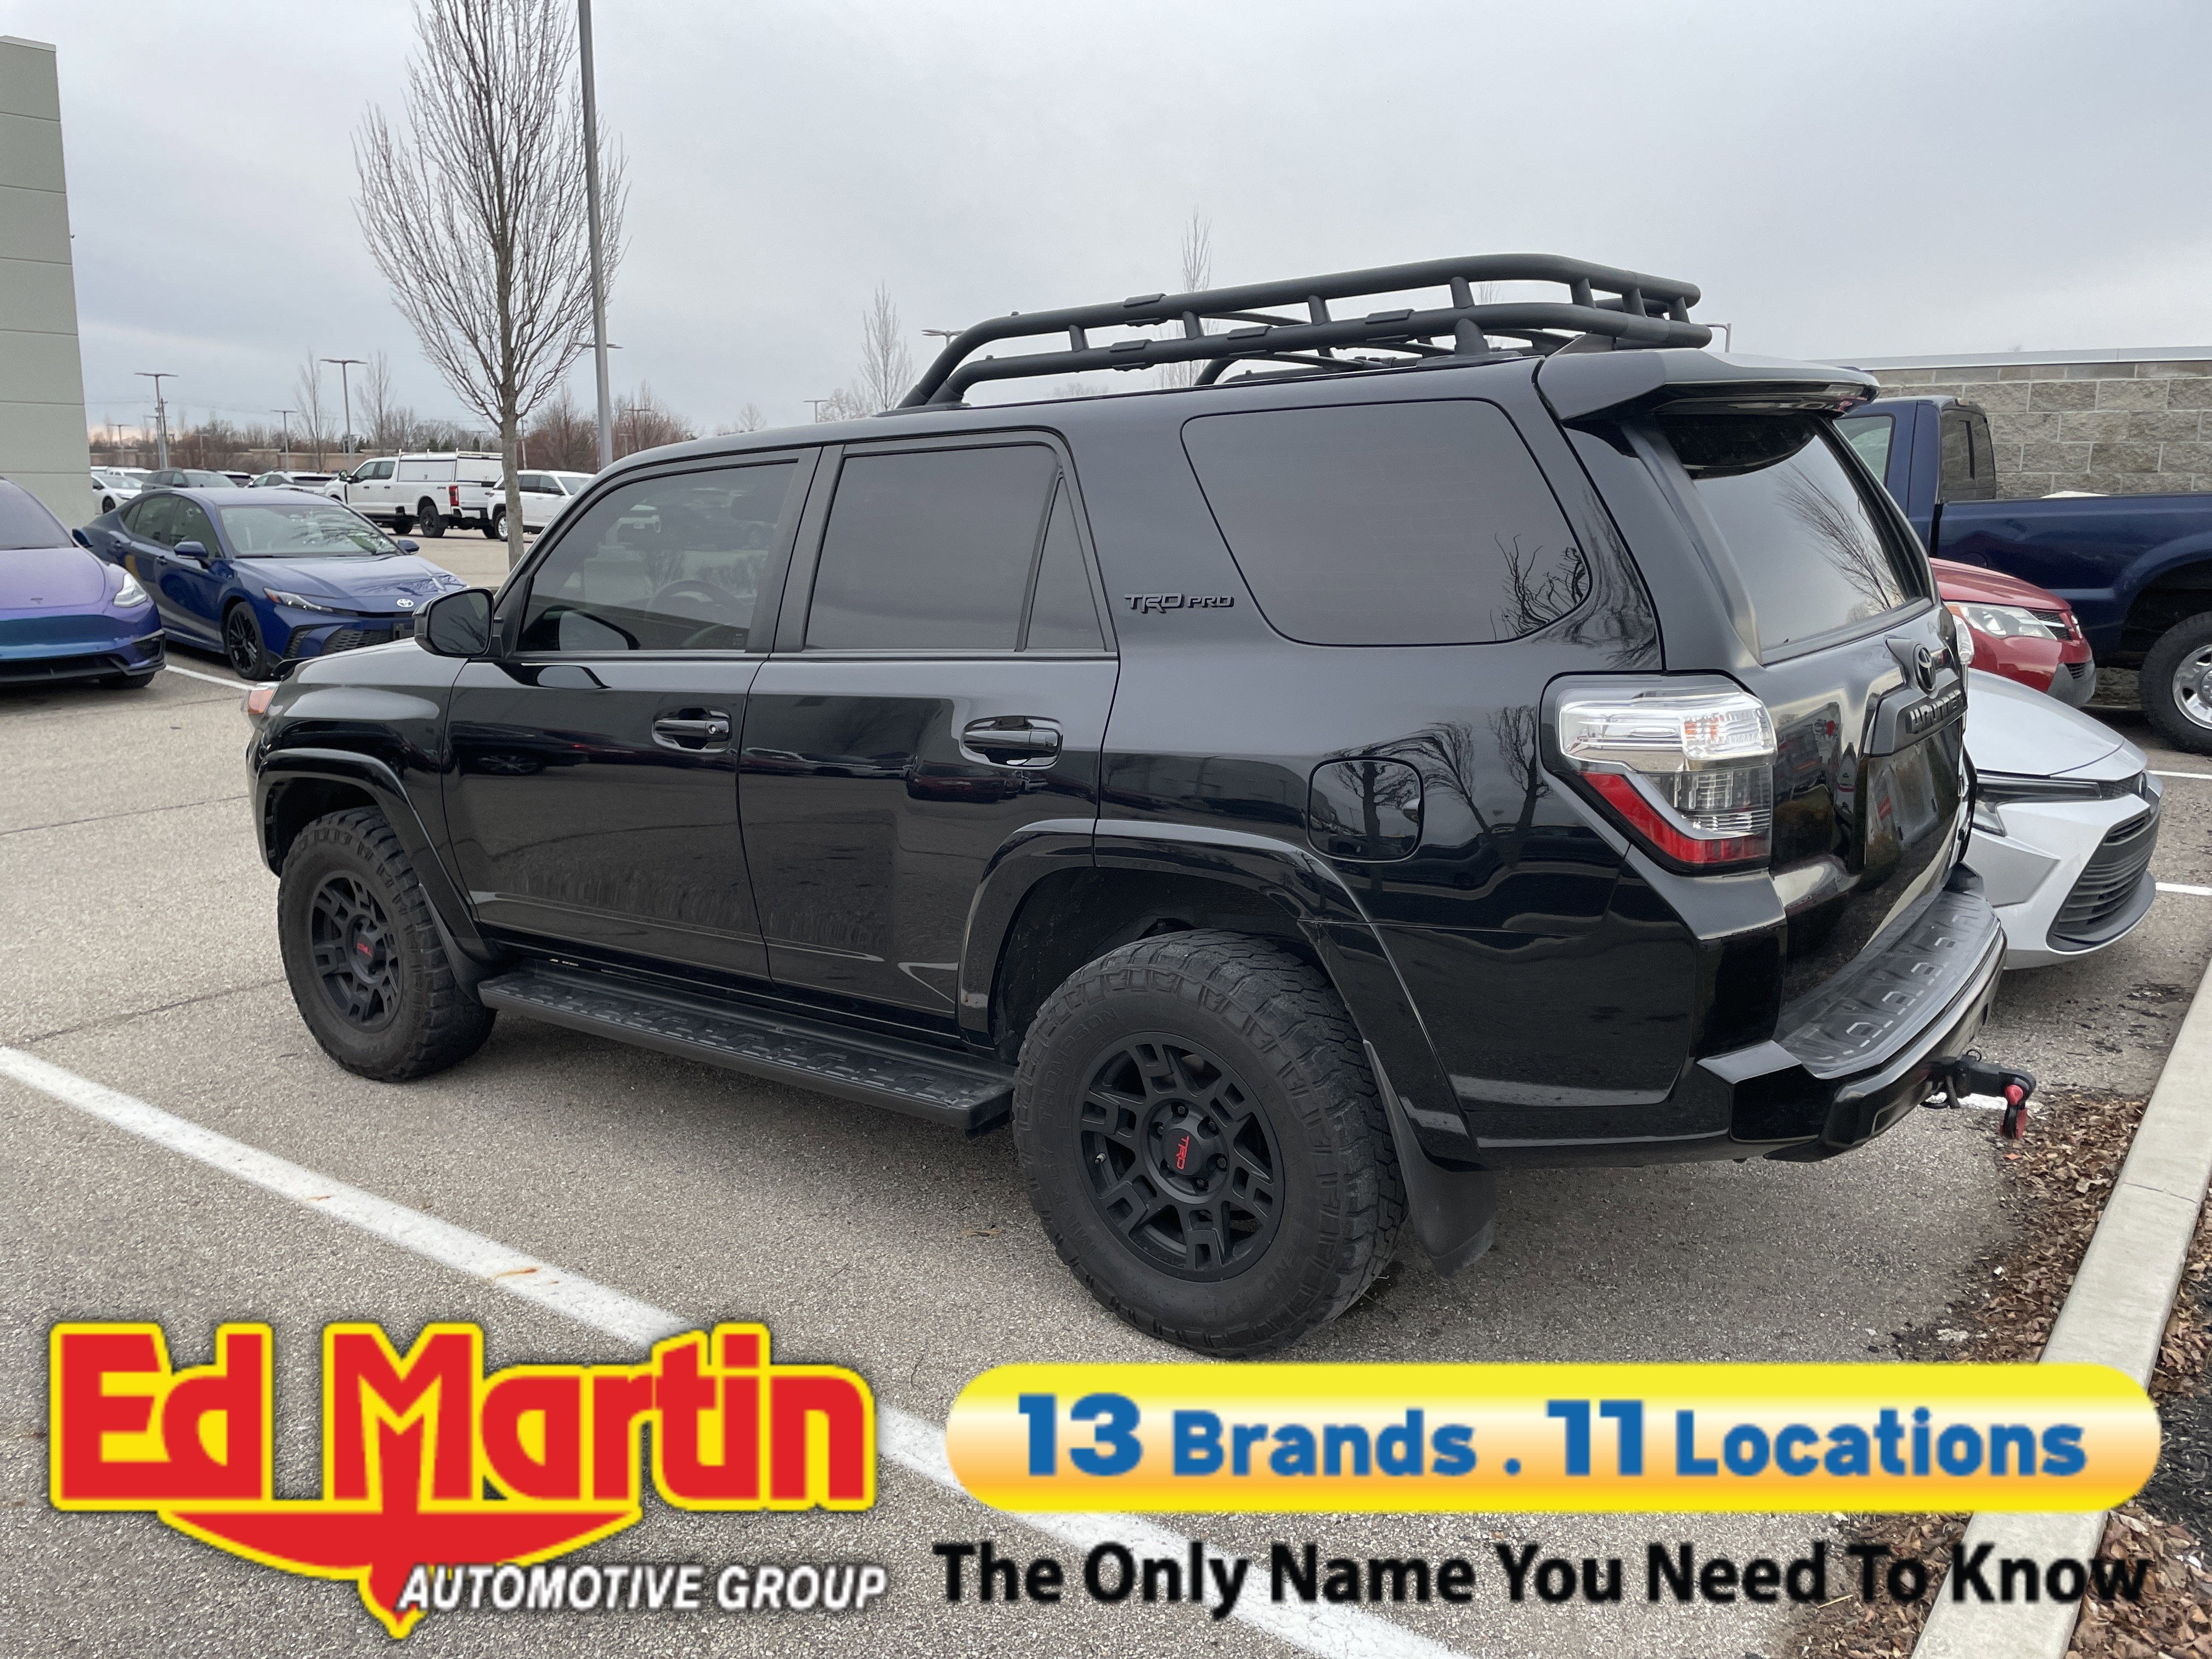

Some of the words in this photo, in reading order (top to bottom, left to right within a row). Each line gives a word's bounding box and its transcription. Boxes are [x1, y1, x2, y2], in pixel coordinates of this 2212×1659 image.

[1124, 593, 1184, 614] TRD
[1188, 595, 1234, 608] PRO
[1176, 1136, 1189, 1170] TRD
